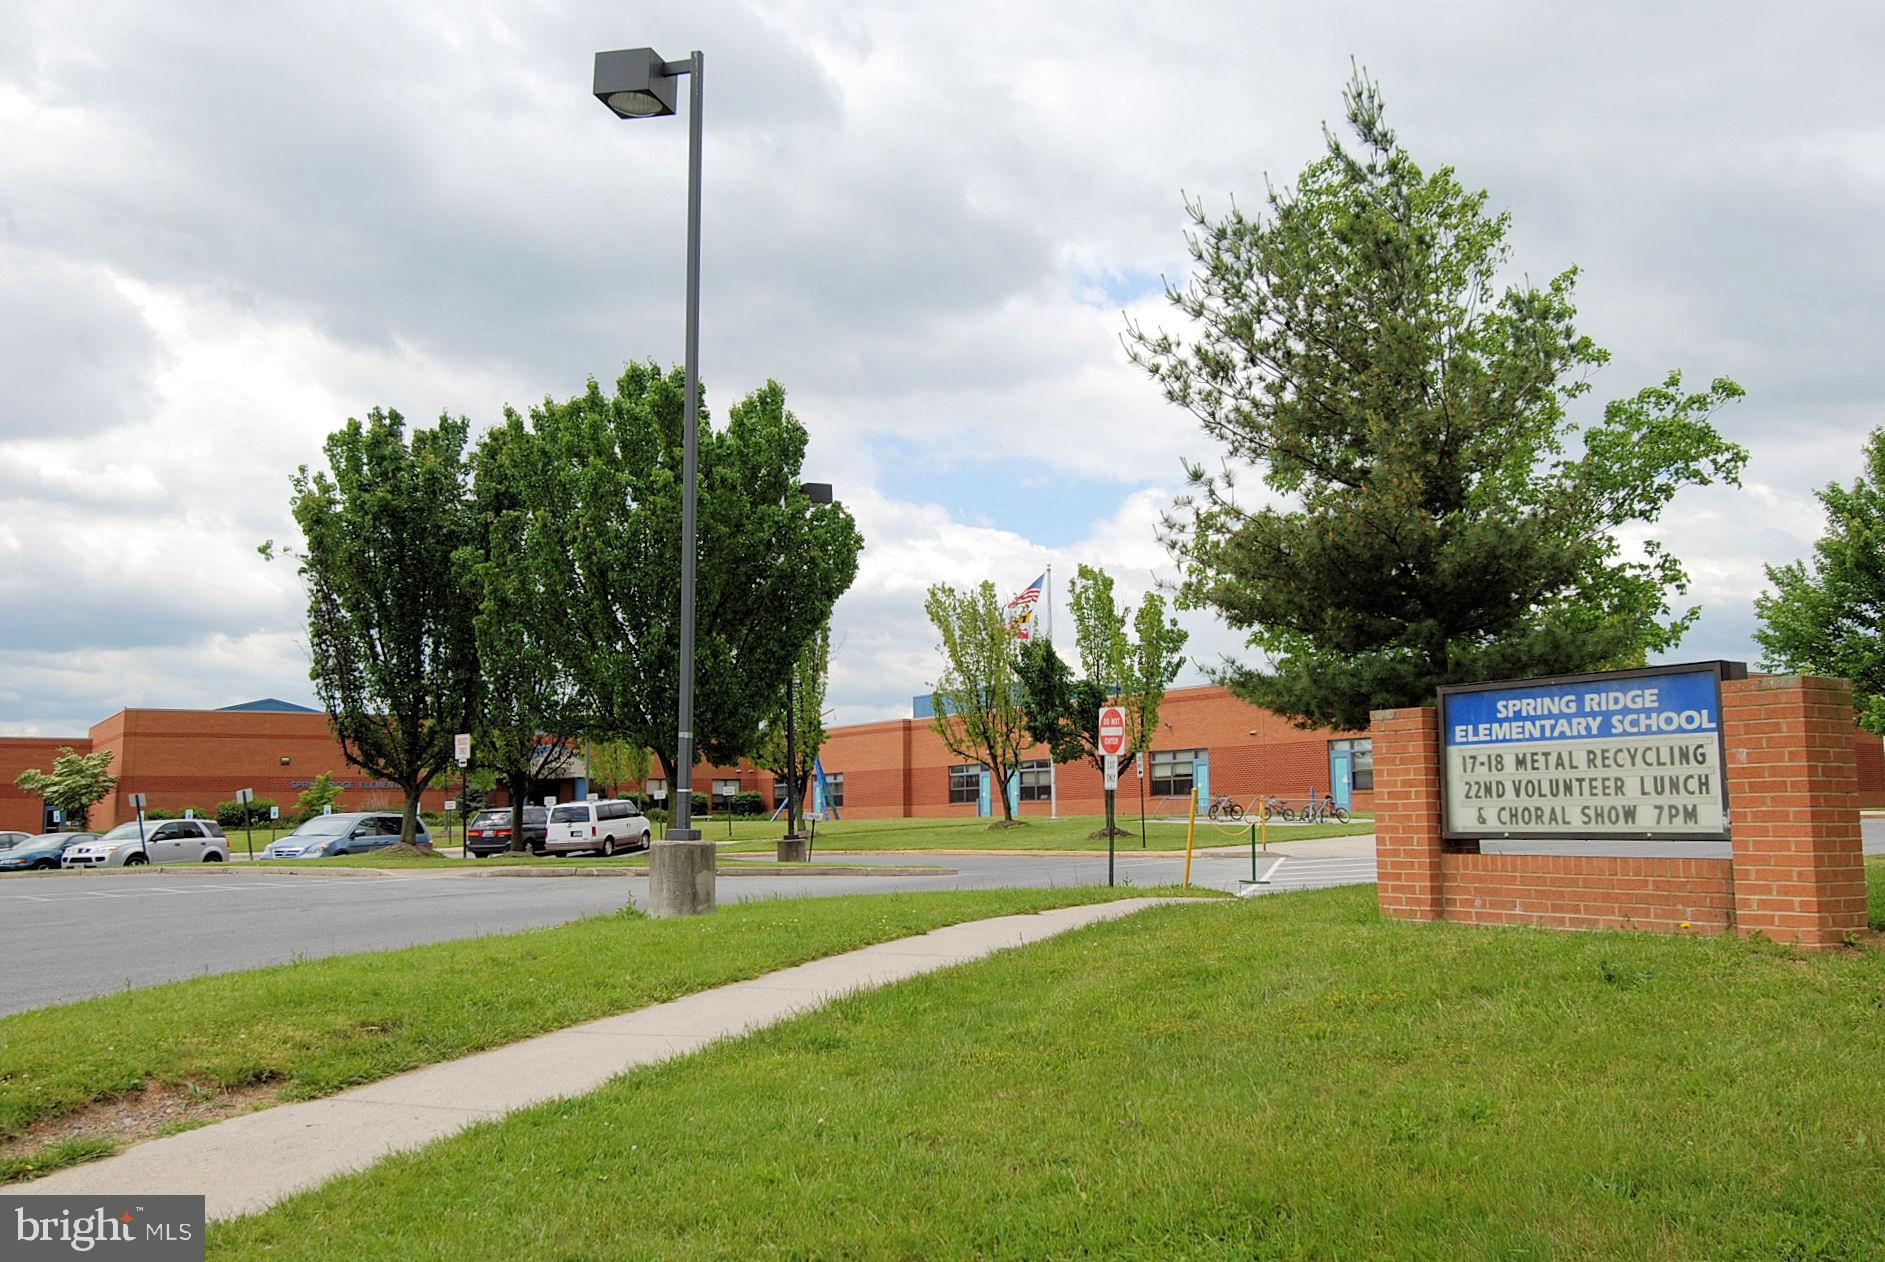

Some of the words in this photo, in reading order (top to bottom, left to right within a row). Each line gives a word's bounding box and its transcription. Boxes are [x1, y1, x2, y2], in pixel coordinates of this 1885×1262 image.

[1496, 697, 1577, 718] SPRING
[1584, 689, 1659, 712] RIDGE
[1111, 717, 1120, 725] NOT
[1455, 716, 1603, 743] ELEMENTARY
[1611, 709, 1717, 735] SCHOOL
[1462, 753, 1505, 774] 17-18
[1515, 751, 1579, 772] METAL
[1587, 744, 1707, 769] RECYCLING
[1464, 780, 1506, 800] 22ND
[1512, 777, 1625, 799] VOLUNTEER
[1640, 774, 1711, 796] LUNCH
[1477, 808, 1487, 825] &
[1497, 806, 1571, 826] CHORAL
[1581, 805, 1638, 825] SHOW
[1654, 804, 1699, 826] 7PM
